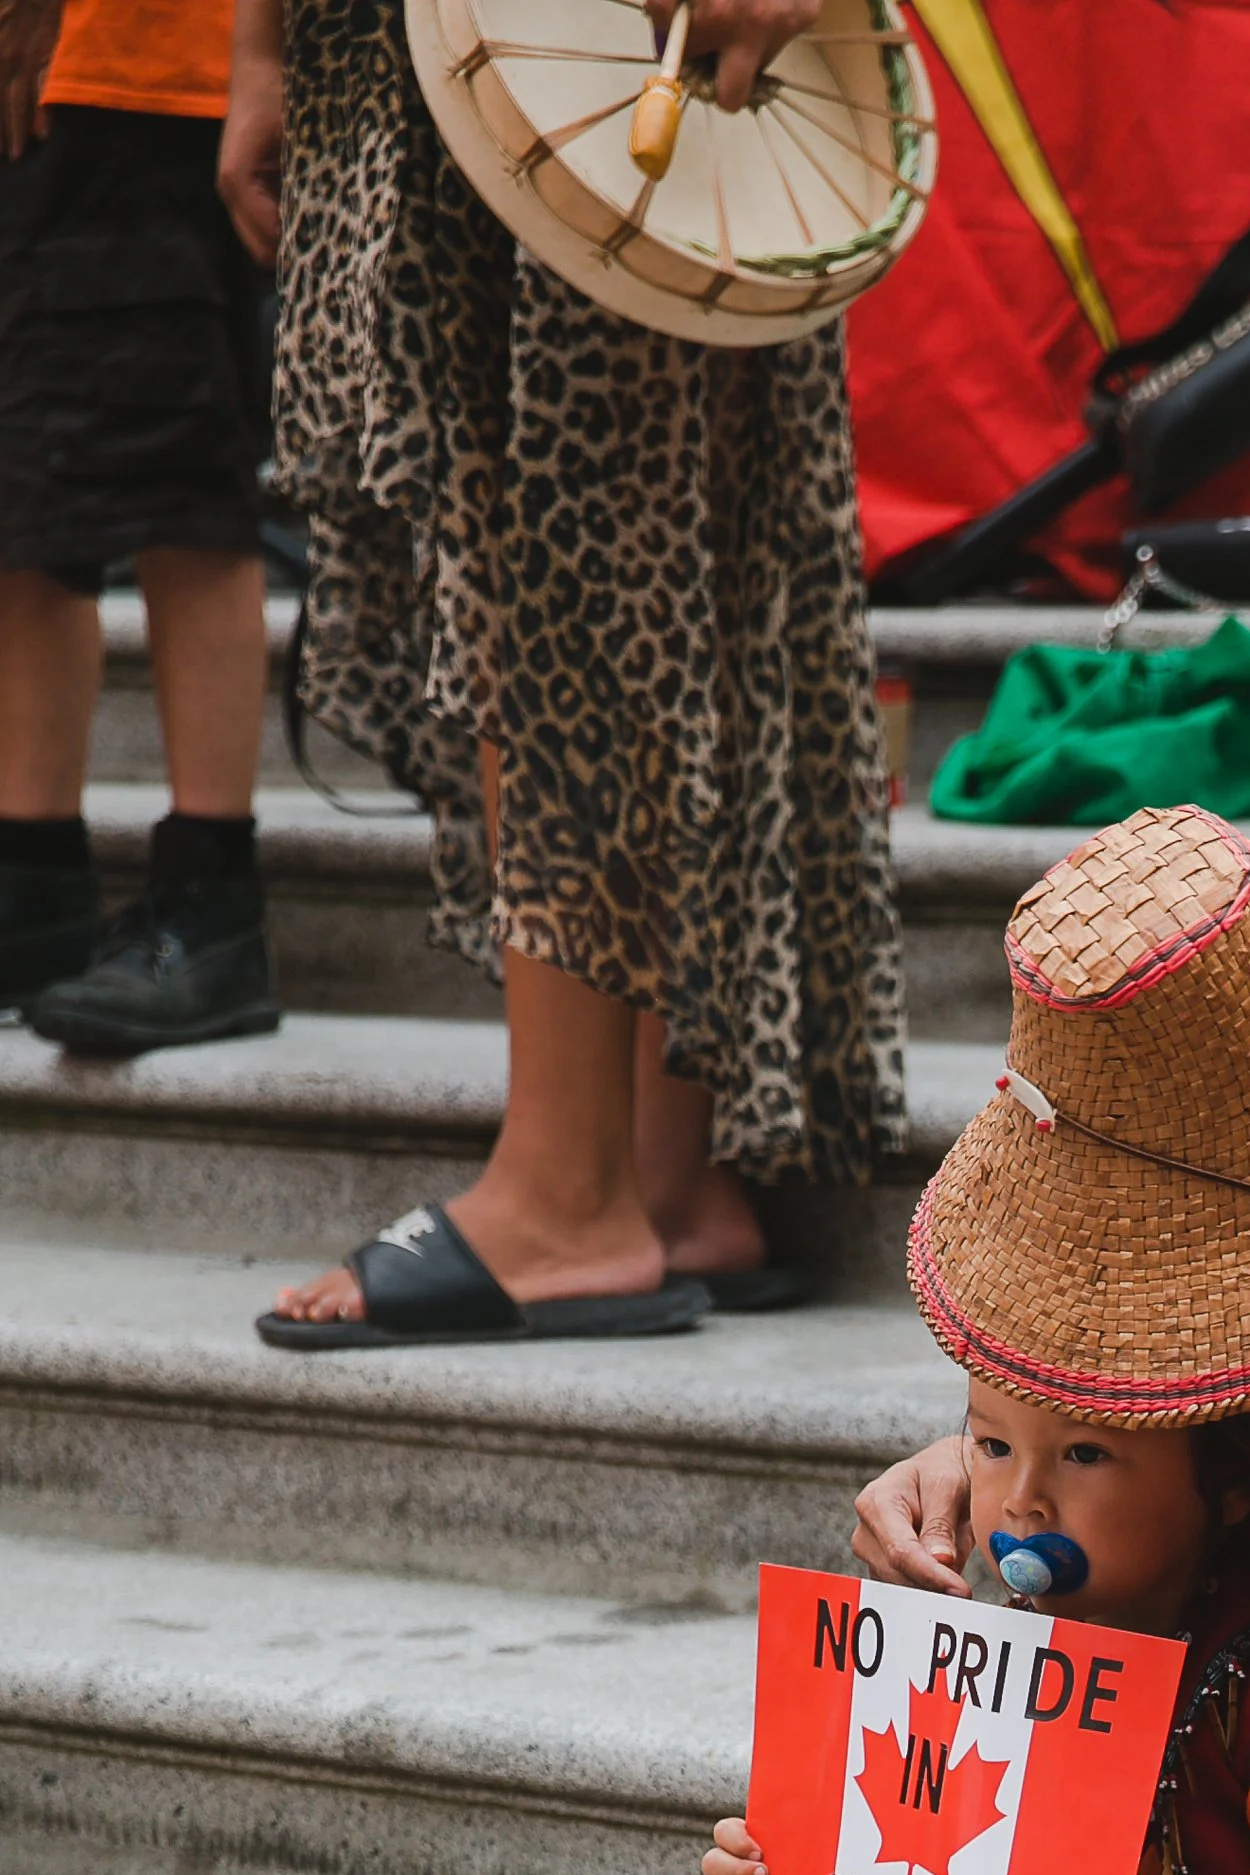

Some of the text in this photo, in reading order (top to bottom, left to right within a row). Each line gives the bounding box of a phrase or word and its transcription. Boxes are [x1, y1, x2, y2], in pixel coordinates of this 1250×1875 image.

[813, 1597, 1125, 1734] NO PRIDE
[899, 1734, 948, 1815] IN
